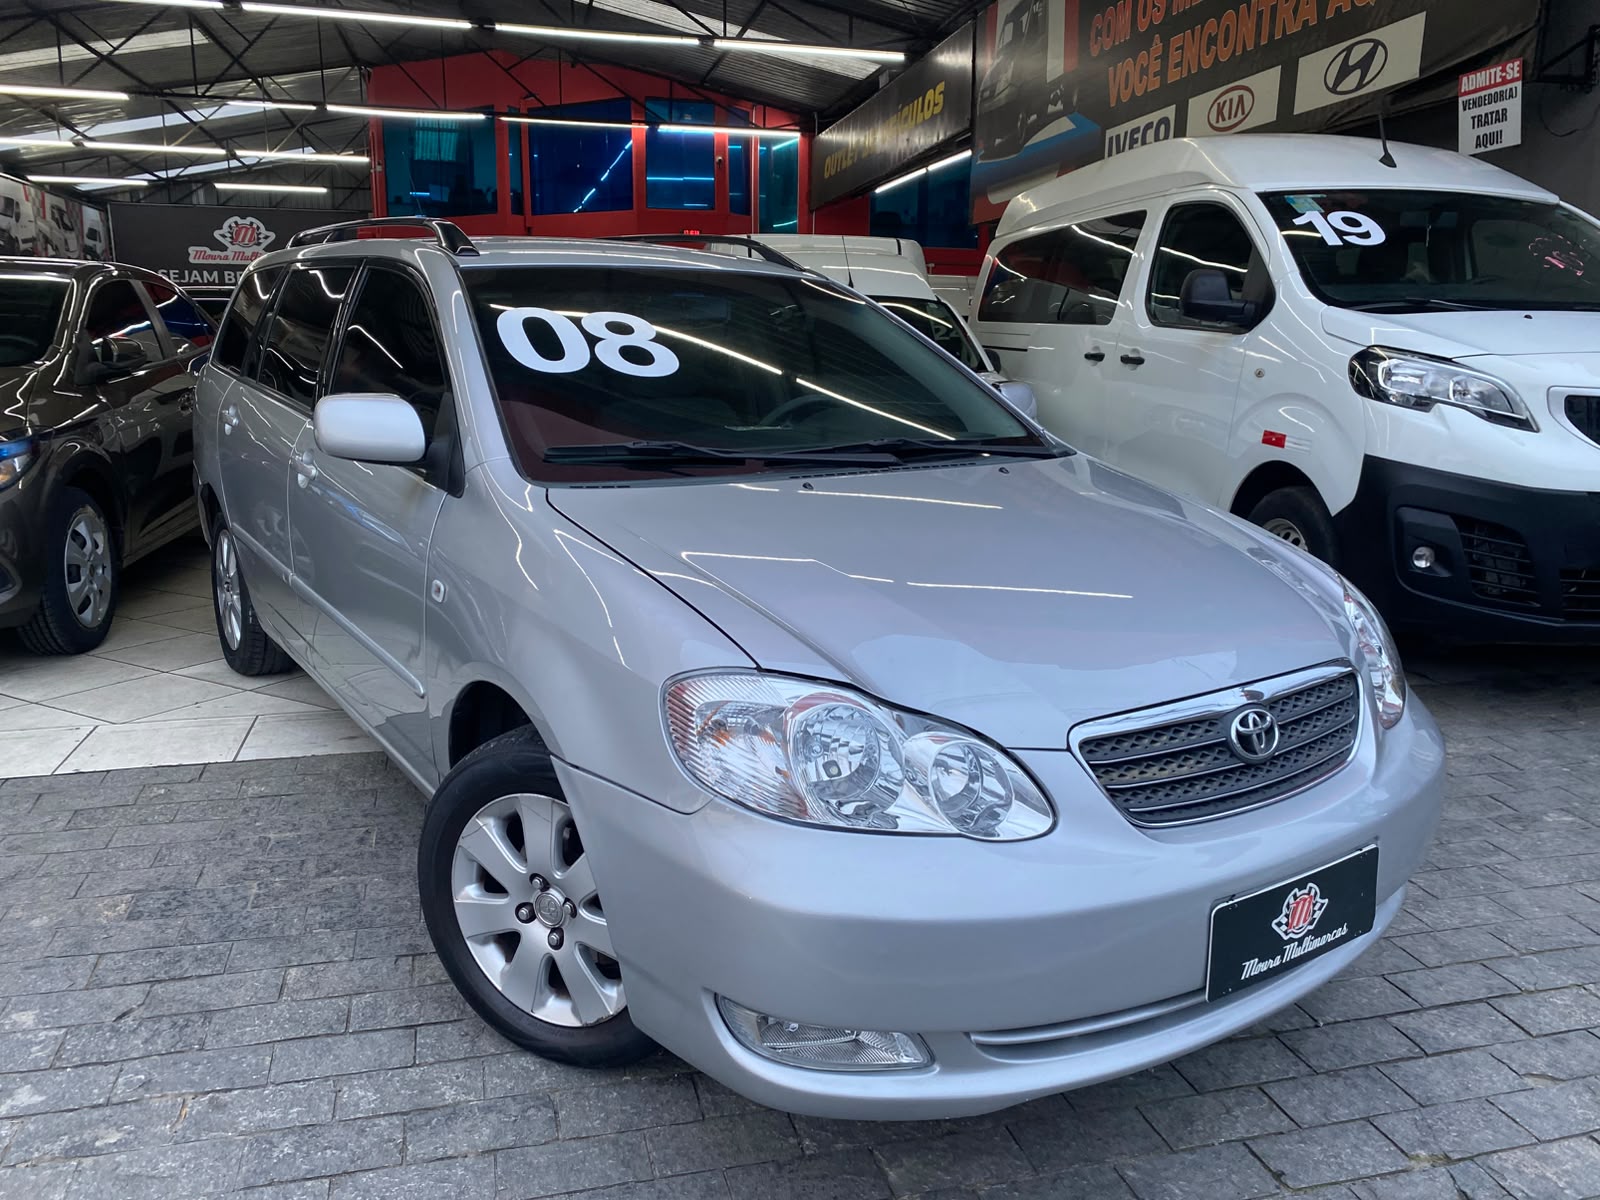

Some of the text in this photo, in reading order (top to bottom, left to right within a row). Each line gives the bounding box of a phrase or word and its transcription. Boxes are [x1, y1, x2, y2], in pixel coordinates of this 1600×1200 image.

[1090, 0, 1166, 57] COM OS
[1108, 0, 1317, 107] VOCÊ ENCONTRA
[1461, 61, 1520, 93] ADMITE-SE
[1215, 94, 1246, 124] KIA
[1462, 86, 1518, 112] VENDEDOR(A)
[1471, 108, 1508, 129] TRATAR
[1475, 129, 1503, 149] AQUI!
[1292, 210, 1386, 246] 19
[192, 249, 229, 261] Moura
[496, 306, 680, 378] 08
[1240, 922, 1349, 980] Moura Multimarcas
